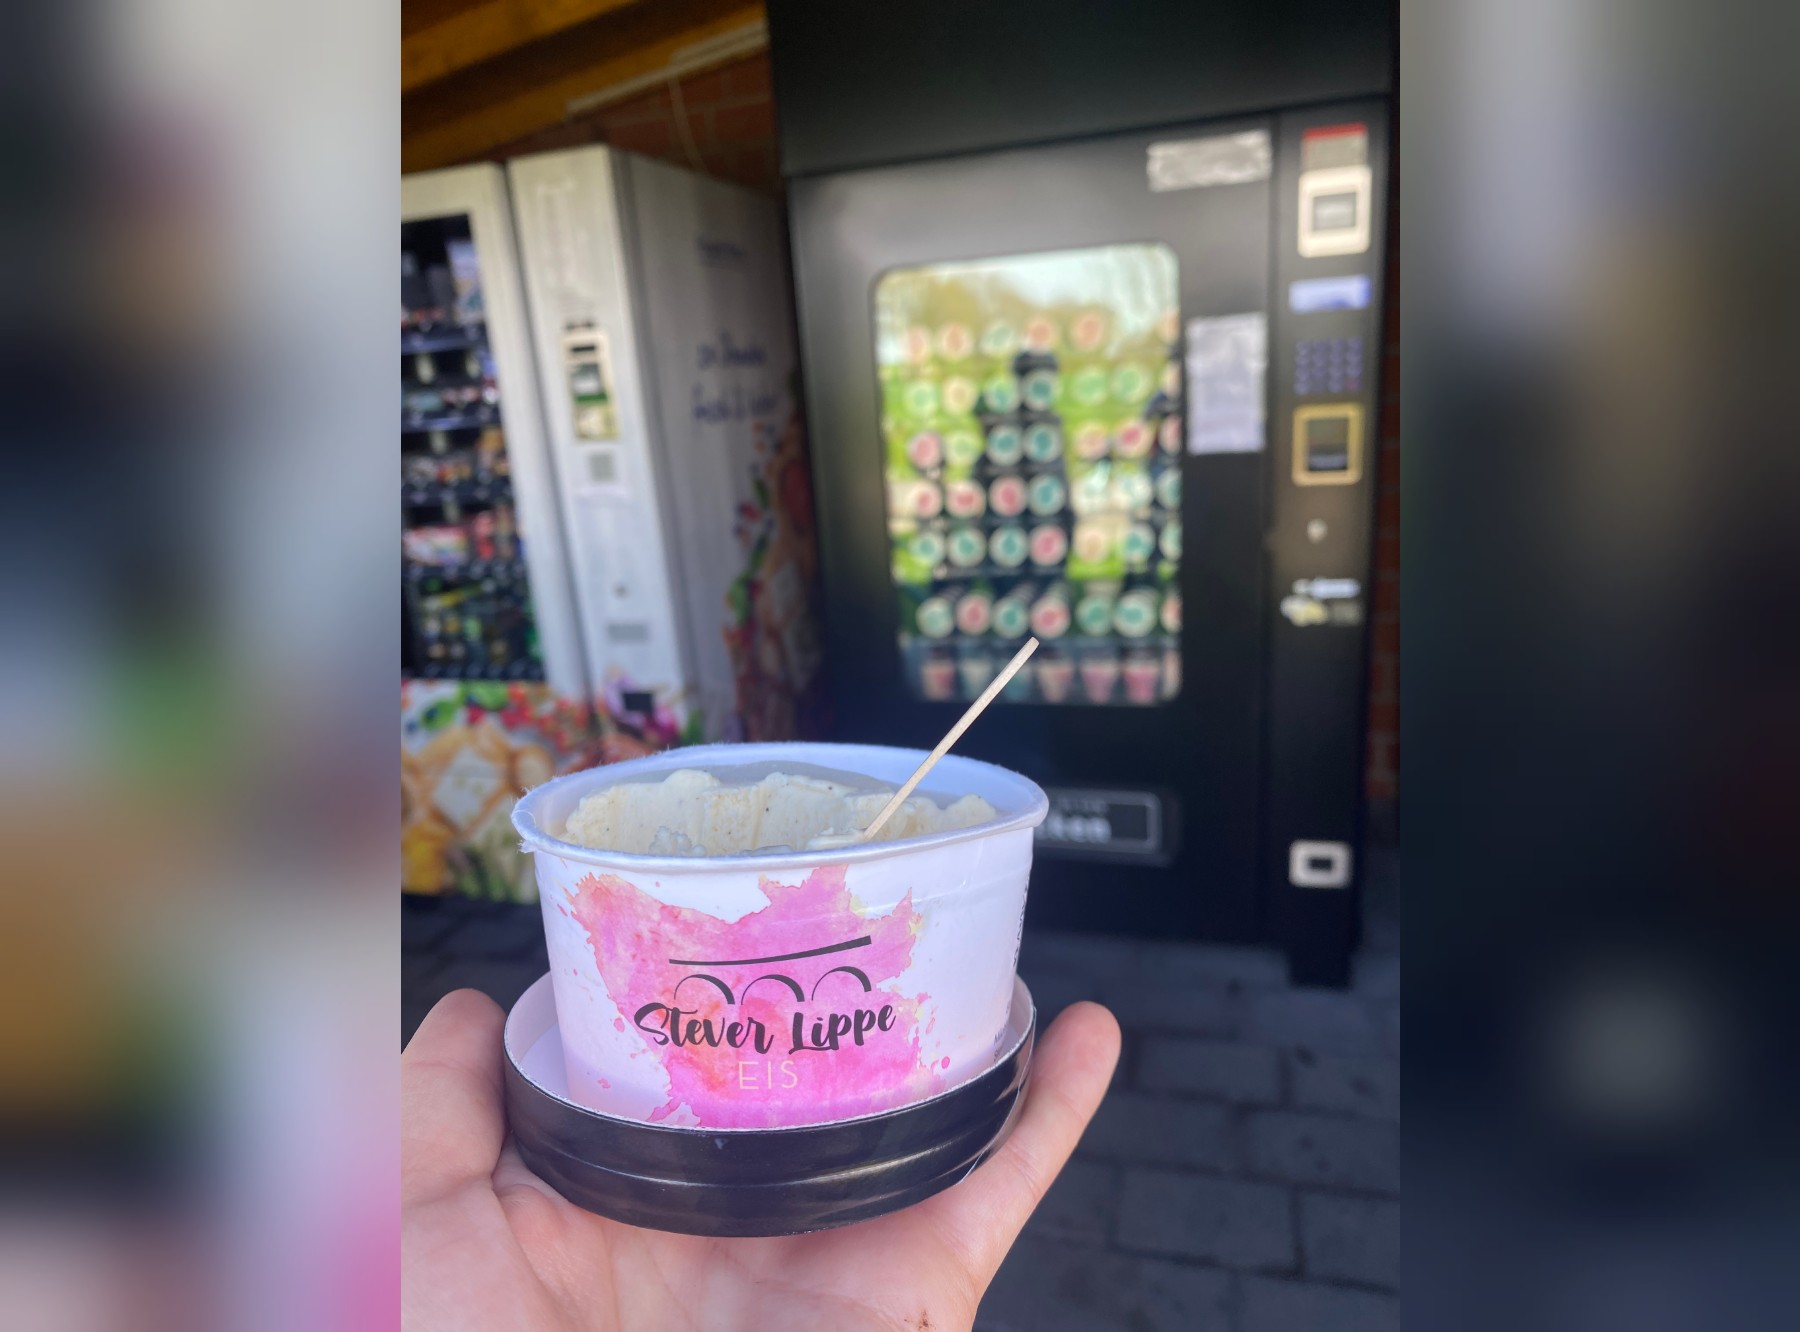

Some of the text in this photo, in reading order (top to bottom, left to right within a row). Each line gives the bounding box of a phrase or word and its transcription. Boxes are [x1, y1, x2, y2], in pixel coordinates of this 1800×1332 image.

[634, 1002, 896, 1054] Stever Lippe
[738, 1060, 798, 1090] EIS
